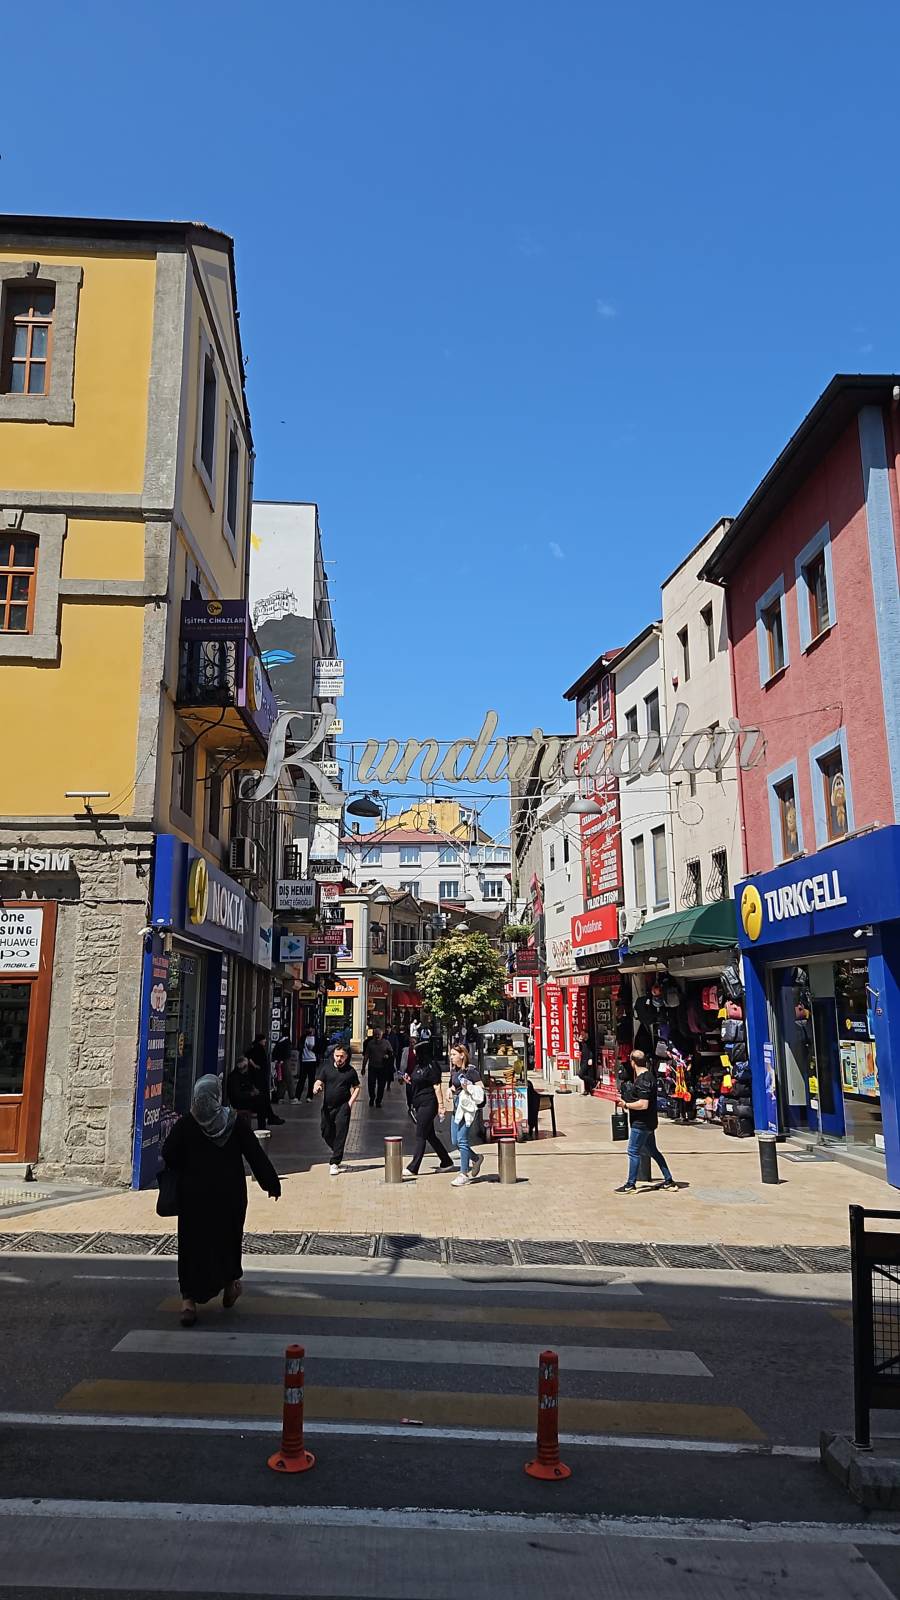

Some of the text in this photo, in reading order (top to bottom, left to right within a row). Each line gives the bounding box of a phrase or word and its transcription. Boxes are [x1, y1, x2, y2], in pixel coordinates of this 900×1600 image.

[316, 660, 342, 668] AVUKAT
[311, 865, 341, 874] AVUKAT
[279, 883, 313, 898] DİŞ HEKİMİ
[764, 869, 848, 922] TURKCELL
[212, 880, 244, 935] NOKTA
[581, 919, 603, 935] vodafone
[518, 981, 528, 993] E
[550, 996, 560, 1056] EXCHANGE
[571, 993, 581, 1058] EXCHANGE
[143, 1107, 161, 1129] Casper
